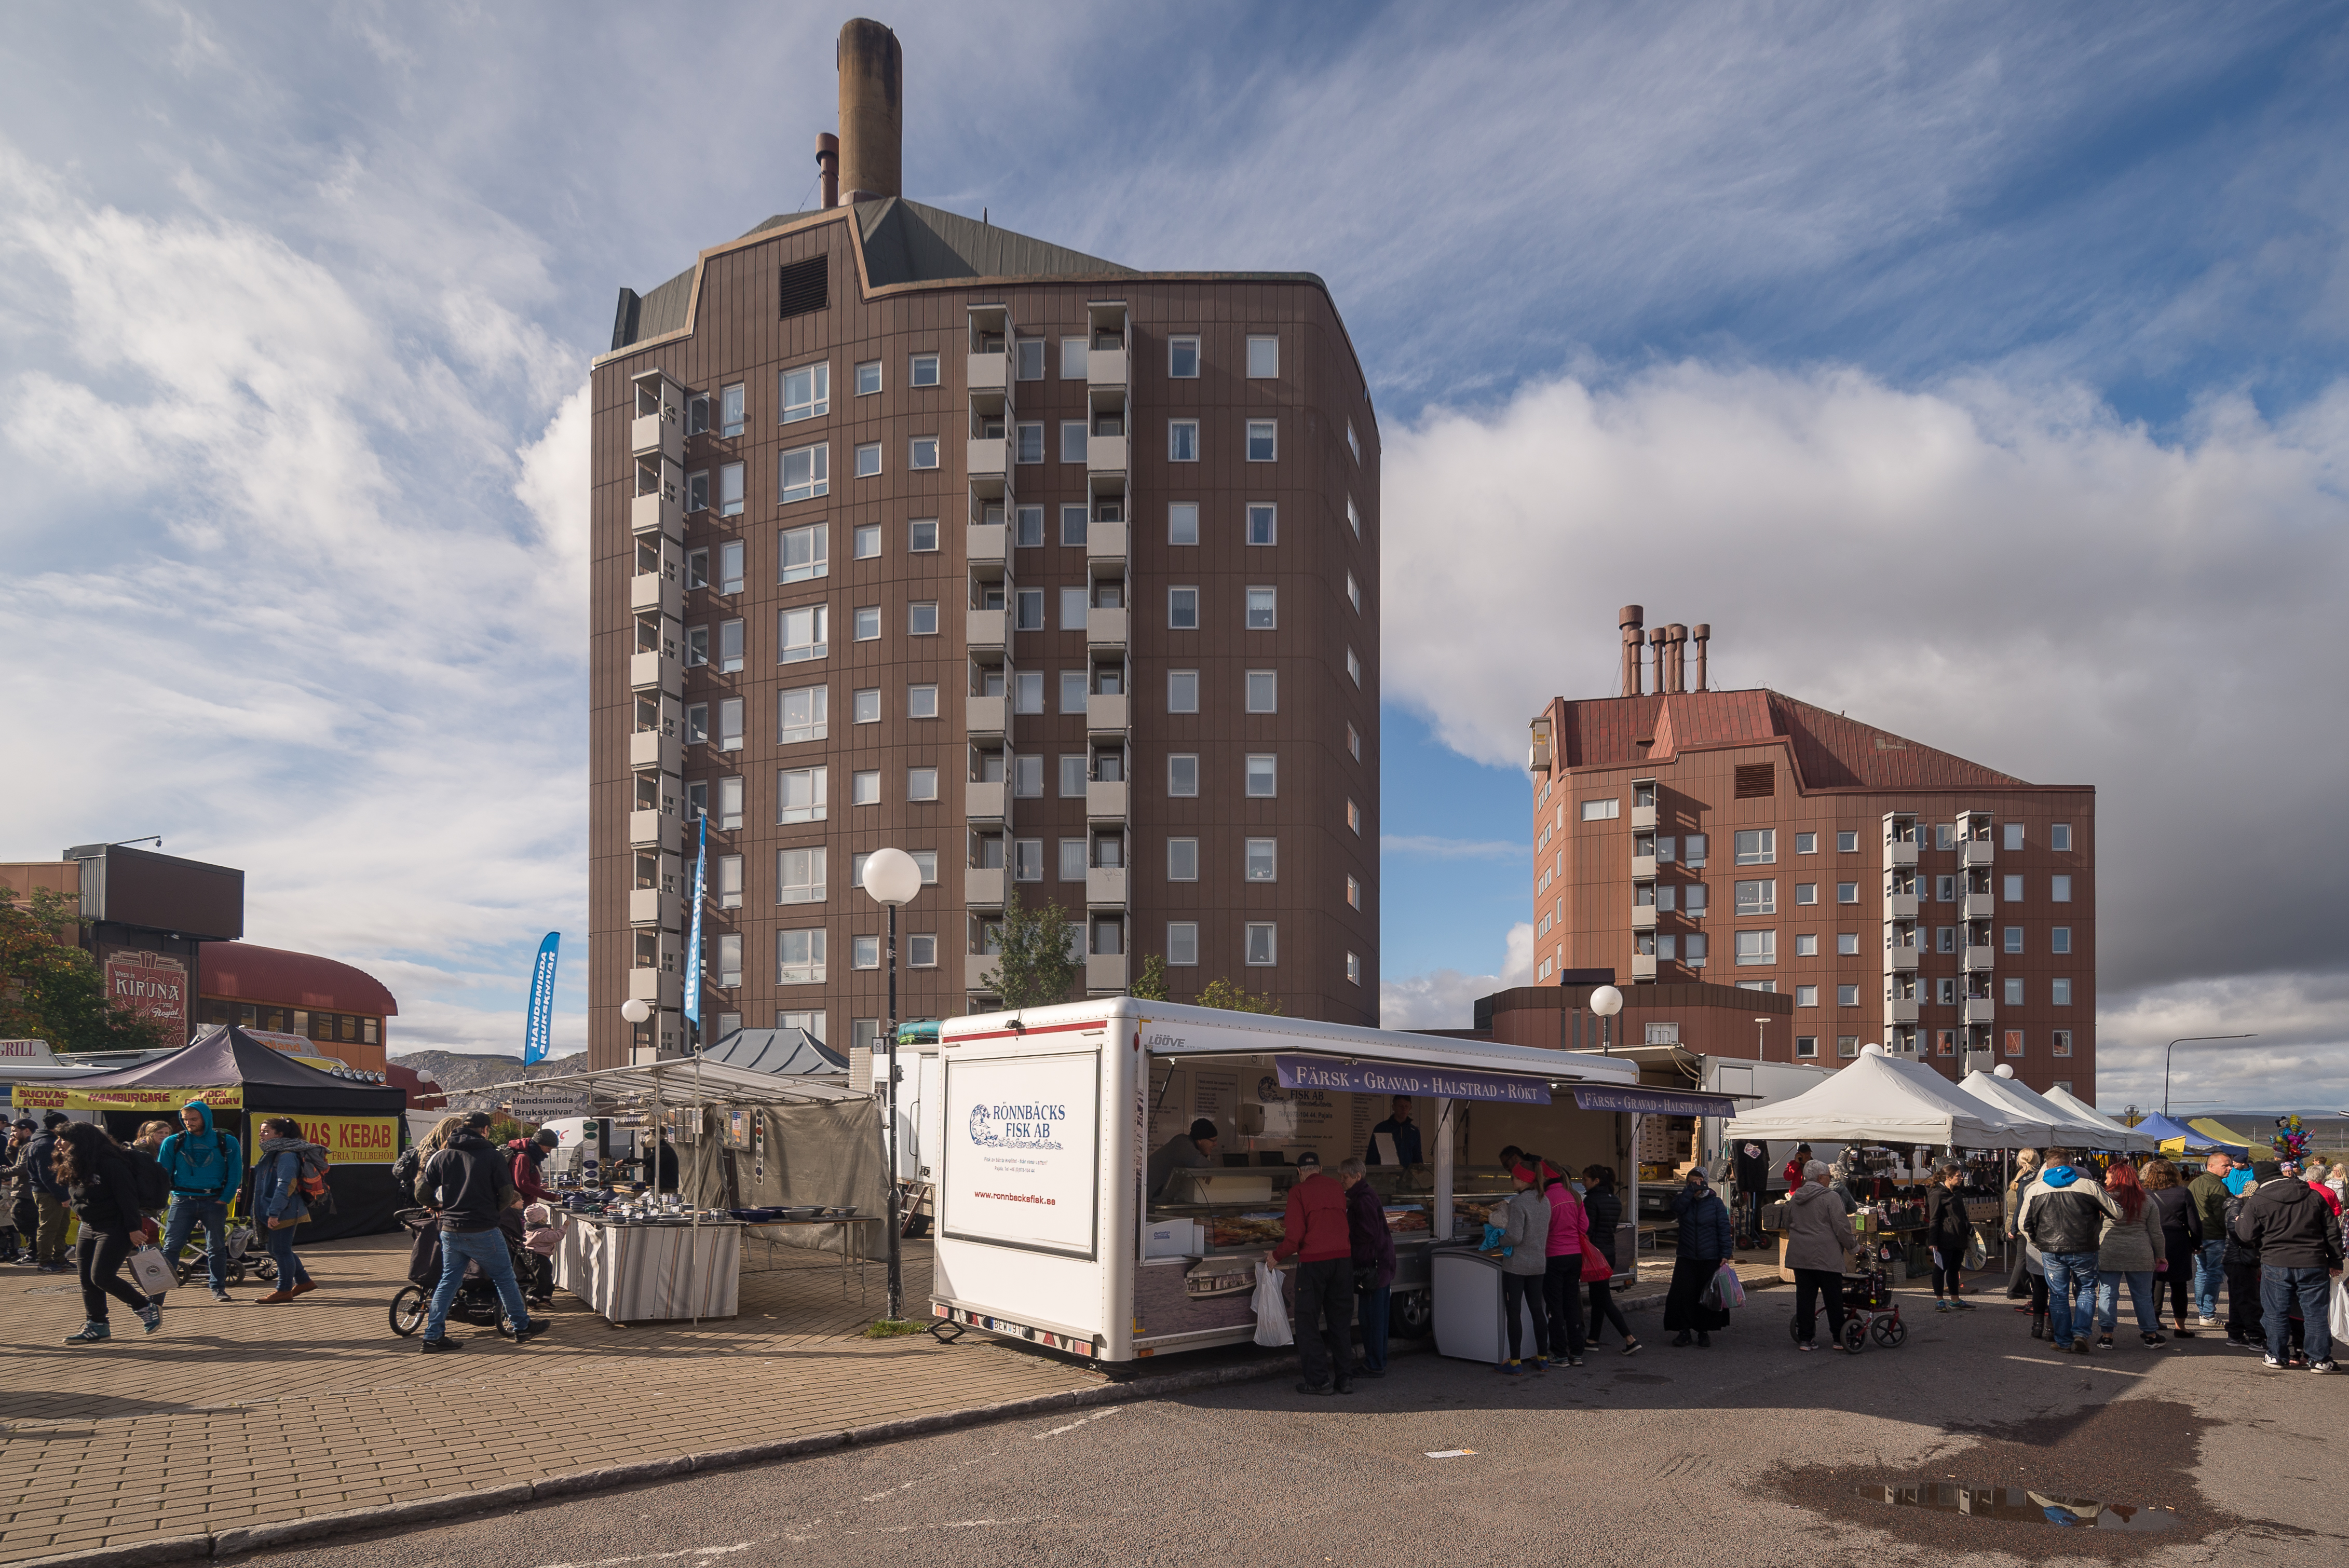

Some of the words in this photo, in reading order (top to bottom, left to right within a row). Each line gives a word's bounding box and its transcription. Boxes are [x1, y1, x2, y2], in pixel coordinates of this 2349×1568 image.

[116, 978, 180, 1001] KIRUNA
[531, 952, 547, 1047] HANDSMIDDA
[539, 951, 555, 1054] BRUKSKNIVAR
[152, 1007, 179, 1018] Royal
[257, 1040, 302, 1052] pland
[1148, 1034, 1186, 1047] LÖÖVE
[1296, 1066, 1350, 1087] FÄRSK
[1364, 1072, 1419, 1092] GRAVAD
[1432, 1077, 1497, 1097] HALSTRAD
[1508, 1083, 1538, 1100] RÖKT
[19, 1090, 69, 1099] SUOVAS
[88, 1093, 170, 1103] HAMBURGARE
[198, 1090, 227, 1098] TJOCK
[1290, 1090, 1310, 1100] FISK
[1312, 1091, 1324, 1100] AB
[23, 1099, 64, 1107] KEBAB
[1584, 1093, 1616, 1108] FÄRSK
[1624, 1096, 1656, 1111] GRAVAD
[1663, 1099, 1703, 1114] HALSTRAD
[1708, 1102, 1728, 1115] RÖKT
[514, 1108, 573, 1116] Bruksknivar
[993, 1101, 1065, 1120] RÖNNBÄCKS
[297, 1122, 331, 1148] VAS
[339, 1124, 391, 1148] KEBAB
[1006, 1123, 1030, 1138] FISK
[1034, 1123, 1050, 1138] AB
[332, 1151, 350, 1161] FRIA
[351, 1150, 395, 1160] TILLBEHÖR
